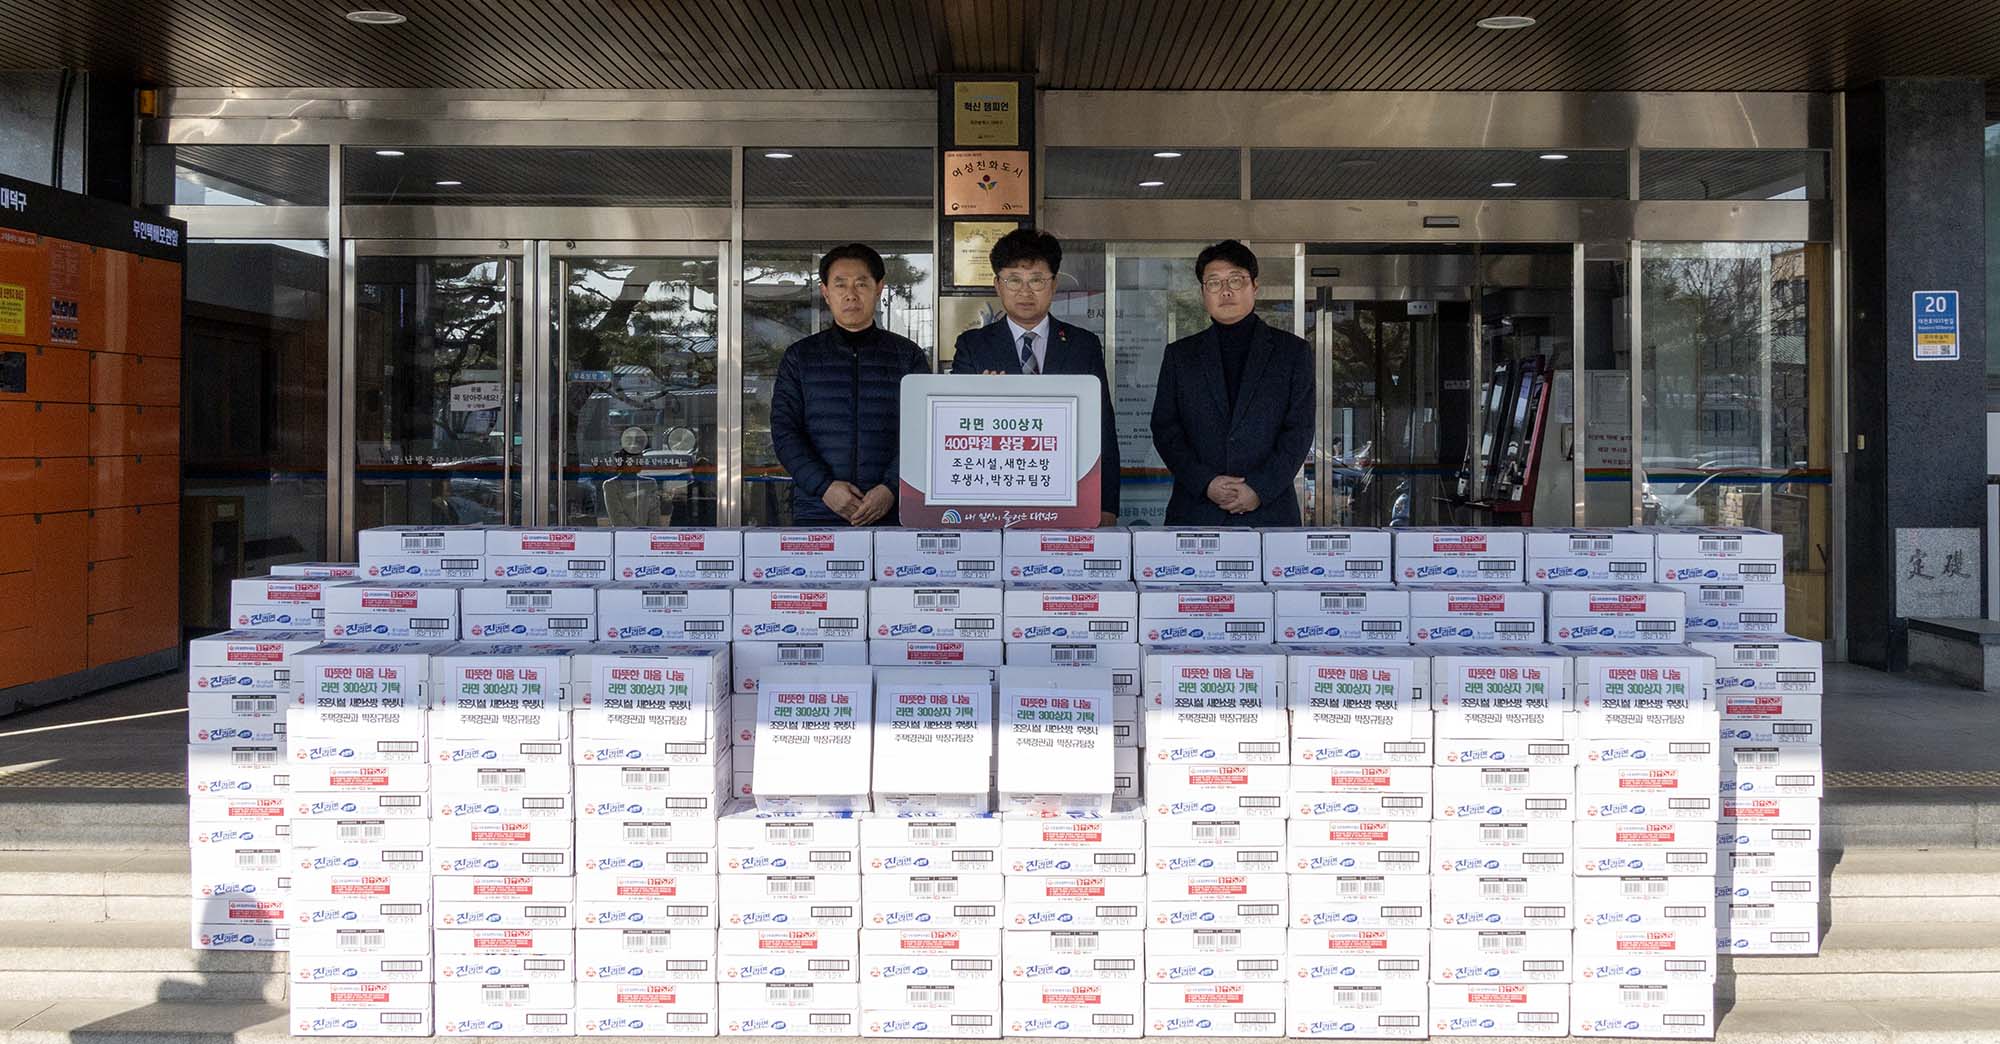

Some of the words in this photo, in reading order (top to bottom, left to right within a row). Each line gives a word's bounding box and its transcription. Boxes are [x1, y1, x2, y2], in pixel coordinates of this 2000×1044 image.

[963, 102, 981, 112] 혁신
[983, 102, 1009, 112] 챔피언
[952, 160, 1024, 178] 여성친화도시
[0, 187, 27, 212] 대덕구
[133, 220, 179, 247] 무인택배보관함
[1925, 296, 1947, 313] 20
[959, 418, 984, 431] 라면
[992, 418, 1044, 432] 300상자
[945, 436, 993, 450] 400만원
[999, 436, 1025, 451] 상당
[1031, 436, 1057, 451] 기탁
[964, 513, 976, 521] 내
[1029, 512, 1058, 521] 대덕구
[325, 668, 352, 679] 따뜻한
[356, 668, 374, 679] 마음
[379, 668, 397, 679] 나눔
[465, 669, 492, 680] 따뜻한
[497, 669, 514, 680] 마음
[519, 669, 537, 680] 나눔
[611, 669, 640, 683] 따뜻한
[644, 669, 661, 683] 마음
[666, 669, 684, 681] 나눔
[1182, 668, 1209, 681] 따뜻한
[1213, 668, 1231, 681] 마음
[1236, 668, 1254, 679] 나눔
[1317, 668, 1347, 682] 따뜻한
[1350, 668, 1368, 680] 마음
[1373, 668, 1390, 681] 나눔
[1468, 668, 1495, 679] 따뜻한
[1500, 668, 1518, 679] 마음
[1522, 669, 1540, 680] 나눔
[1609, 669, 1636, 680] 따뜻한
[1640, 669, 1658, 680] 마음
[1663, 669, 1680, 680] 나눔
[321, 682, 339, 693] 라면
[343, 682, 377, 693] 300상자
[382, 682, 400, 693] 기탁
[462, 683, 479, 694] 라면
[483, 683, 517, 695] 300상자
[522, 684, 541, 694] 기탁
[608, 683, 626, 694] 라면
[630, 684, 665, 695] 300상자
[669, 684, 688, 696] 기탁
[1179, 682, 1196, 693] 라면
[1200, 682, 1235, 693] 300상자
[1240, 682, 1258, 693] 기탁
[1315, 682, 1333, 693] 라면
[1337, 680, 1371, 695] 300상자
[1376, 680, 1394, 696] 기탁
[1465, 683, 1483, 693] 라면
[1487, 683, 1521, 694] 300상자
[1526, 683, 1544, 694] 기탁
[1606, 683, 1624, 694] 라면
[1627, 683, 1662, 695] 300상자
[1666, 683, 1684, 694] 기탁
[316, 698, 346, 707] 조은시설
[350, 698, 378, 708] 새한소방
[382, 698, 405, 708] 후생사
[457, 699, 486, 709] 조은시설
[490, 699, 518, 709] 새한소방
[522, 700, 544, 709] 후생사
[603, 699, 633, 709] 조은시설
[636, 699, 665, 710] 새한소방
[669, 699, 691, 710] 후생사
[777, 694, 805, 706] 따뜻한
[809, 694, 828, 706] 마음
[831, 694, 850, 706] 나눔
[899, 695, 926, 704] 따뜻한
[930, 695, 947, 704] 마음
[952, 695, 969, 704] 나눔
[1019, 698, 1047, 710] 따뜻한
[1051, 698, 1069, 710] 마음
[1074, 698, 1091, 709] 나눔
[1174, 698, 1203, 708] 조은시설
[1207, 698, 1236, 708] 새한소방
[1240, 698, 1263, 708] 후생사
[1309, 698, 1339, 708] 조은시설
[1343, 698, 1371, 709] 새한소방
[1375, 698, 1398, 710] 후생사
[1461, 698, 1490, 708] 조은시설
[1493, 698, 1522, 708] 새한소방
[1526, 698, 1549, 708] 후생사
[1603, 699, 1630, 708] 조은시설
[1634, 699, 1663, 709] 새한소방
[1667, 699, 1688, 709] 후생사
[321, 713, 358, 723] 주택경관과
[362, 713, 399, 723] 박장규팀장
[774, 707, 792, 717] 라면
[796, 707, 830, 719] 300상자
[834, 707, 852, 717] 기탁
[896, 707, 913, 719] 라면
[917, 707, 951, 717] 300상자
[956, 707, 973, 717] 기탁
[1017, 710, 1035, 723] 라면
[1039, 709, 1072, 723] 300상자
[1077, 709, 1095, 722] 기탁
[1178, 713, 1216, 723] 주택경관과
[1220, 713, 1258, 723] 박장규팀장
[1465, 714, 1502, 723] 주택경관과
[1506, 714, 1544, 723] 박장규팀장
[461, 715, 498, 724] 주택경관과
[502, 715, 540, 725] 박장규팀장
[608, 714, 645, 724] 주택경관과
[649, 715, 687, 725] 박장규팀장
[1314, 713, 1351, 723] 주택경관과
[1355, 714, 1393, 725] 박장규팀장
[1606, 714, 1643, 724] 주택경관과
[1647, 714, 1685, 724] 박장규팀장
[768, 721, 798, 730] 조은시설
[802, 721, 830, 730] 새한소방
[834, 721, 855, 730] 후생사
[890, 721, 920, 729] 조은시설
[924, 721, 952, 729] 새한소방
[956, 721, 977, 729] 후생사
[1012, 724, 1041, 733] 조은시설
[1045, 724, 1073, 734] 새한소방
[1077, 724, 1098, 735] 후생사
[773, 735, 810, 744] 주택경관과
[814, 735, 851, 744] 박장규팀장
[896, 734, 932, 743] 주택경관과
[936, 734, 973, 743] 박장규팀장
[1017, 738, 1053, 747] 주택경관과
[1057, 739, 1094, 748] 박장규팀장
